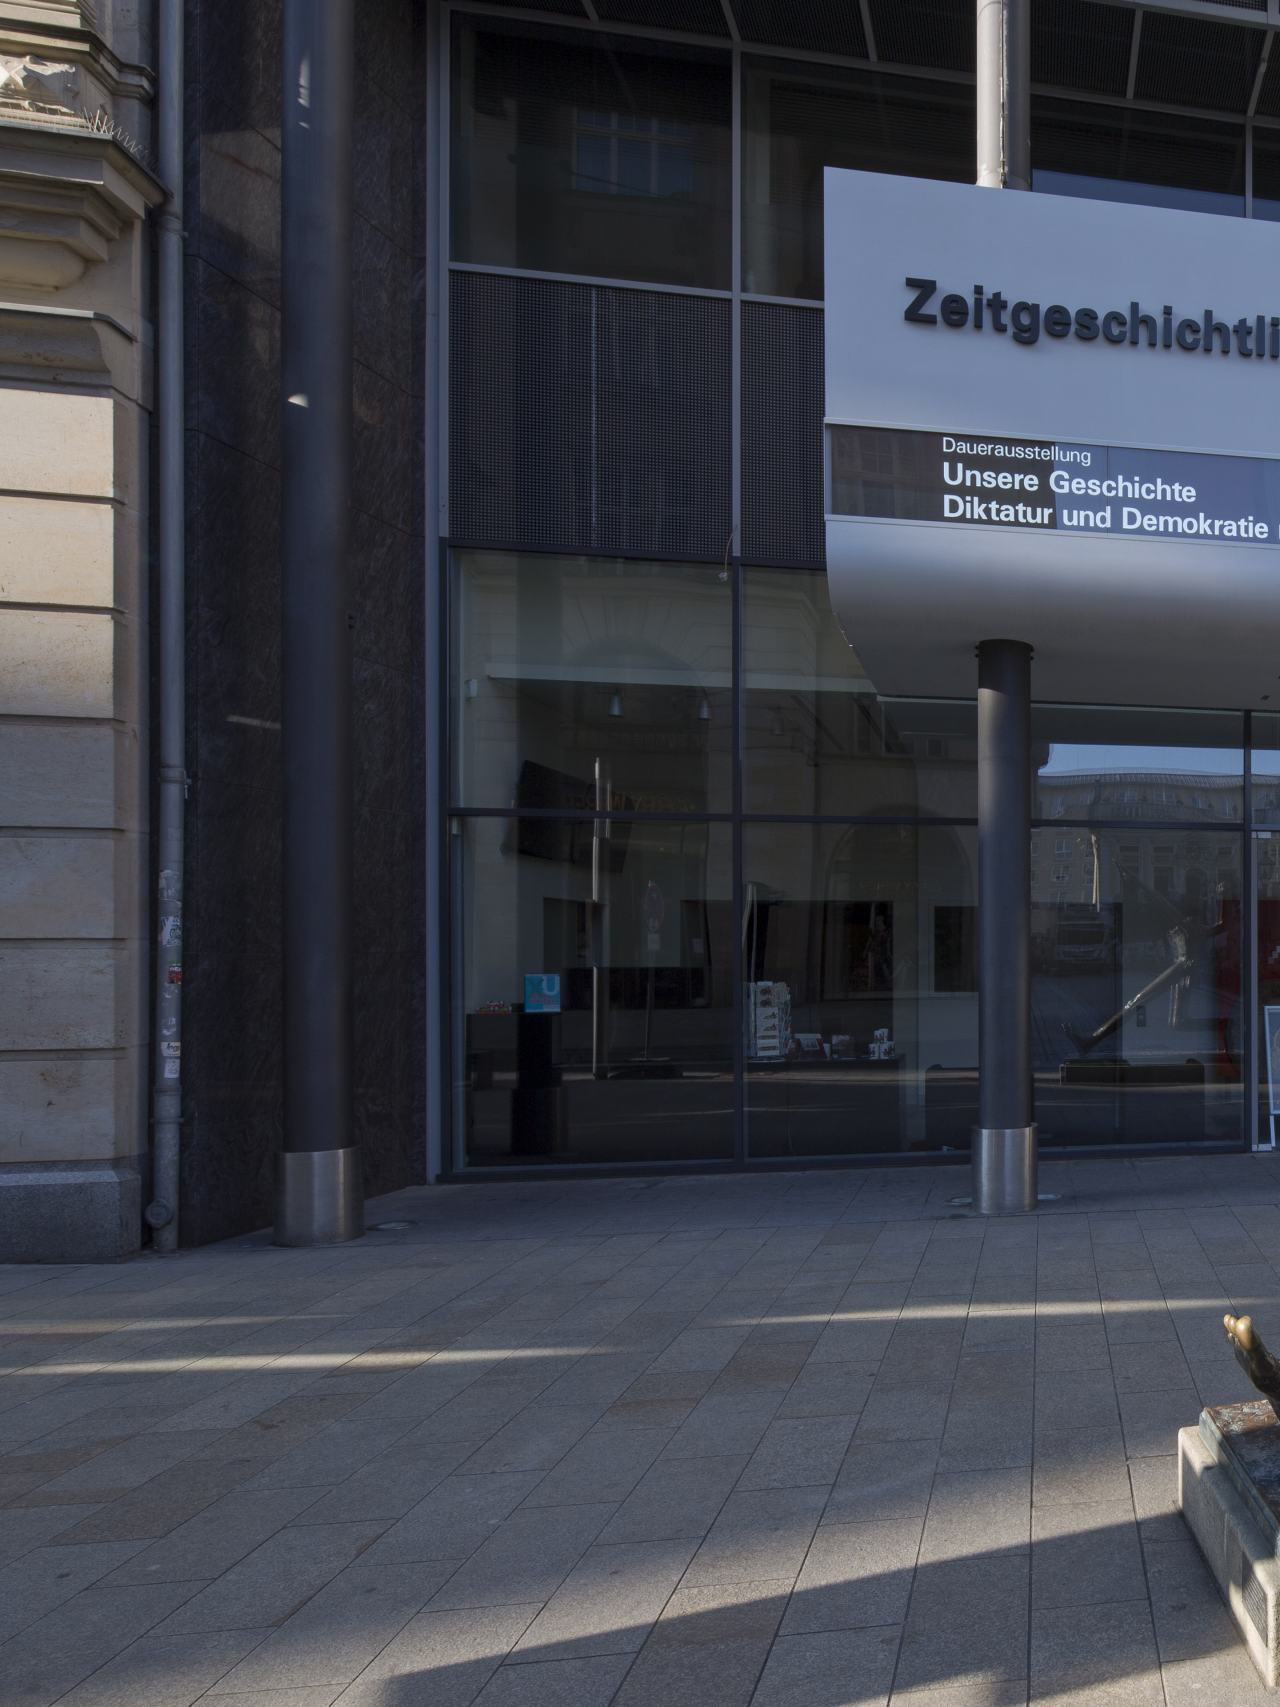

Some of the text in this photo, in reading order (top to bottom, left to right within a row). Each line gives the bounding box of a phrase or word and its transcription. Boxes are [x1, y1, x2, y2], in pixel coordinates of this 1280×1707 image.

[942, 437, 1091, 466] Dauerausstellung
[943, 461, 1196, 502] Unsere Geschichte
[943, 494, 1053, 524] Diktatur
[1062, 506, 1111, 528] und
[1122, 507, 1269, 539] Demokratie
